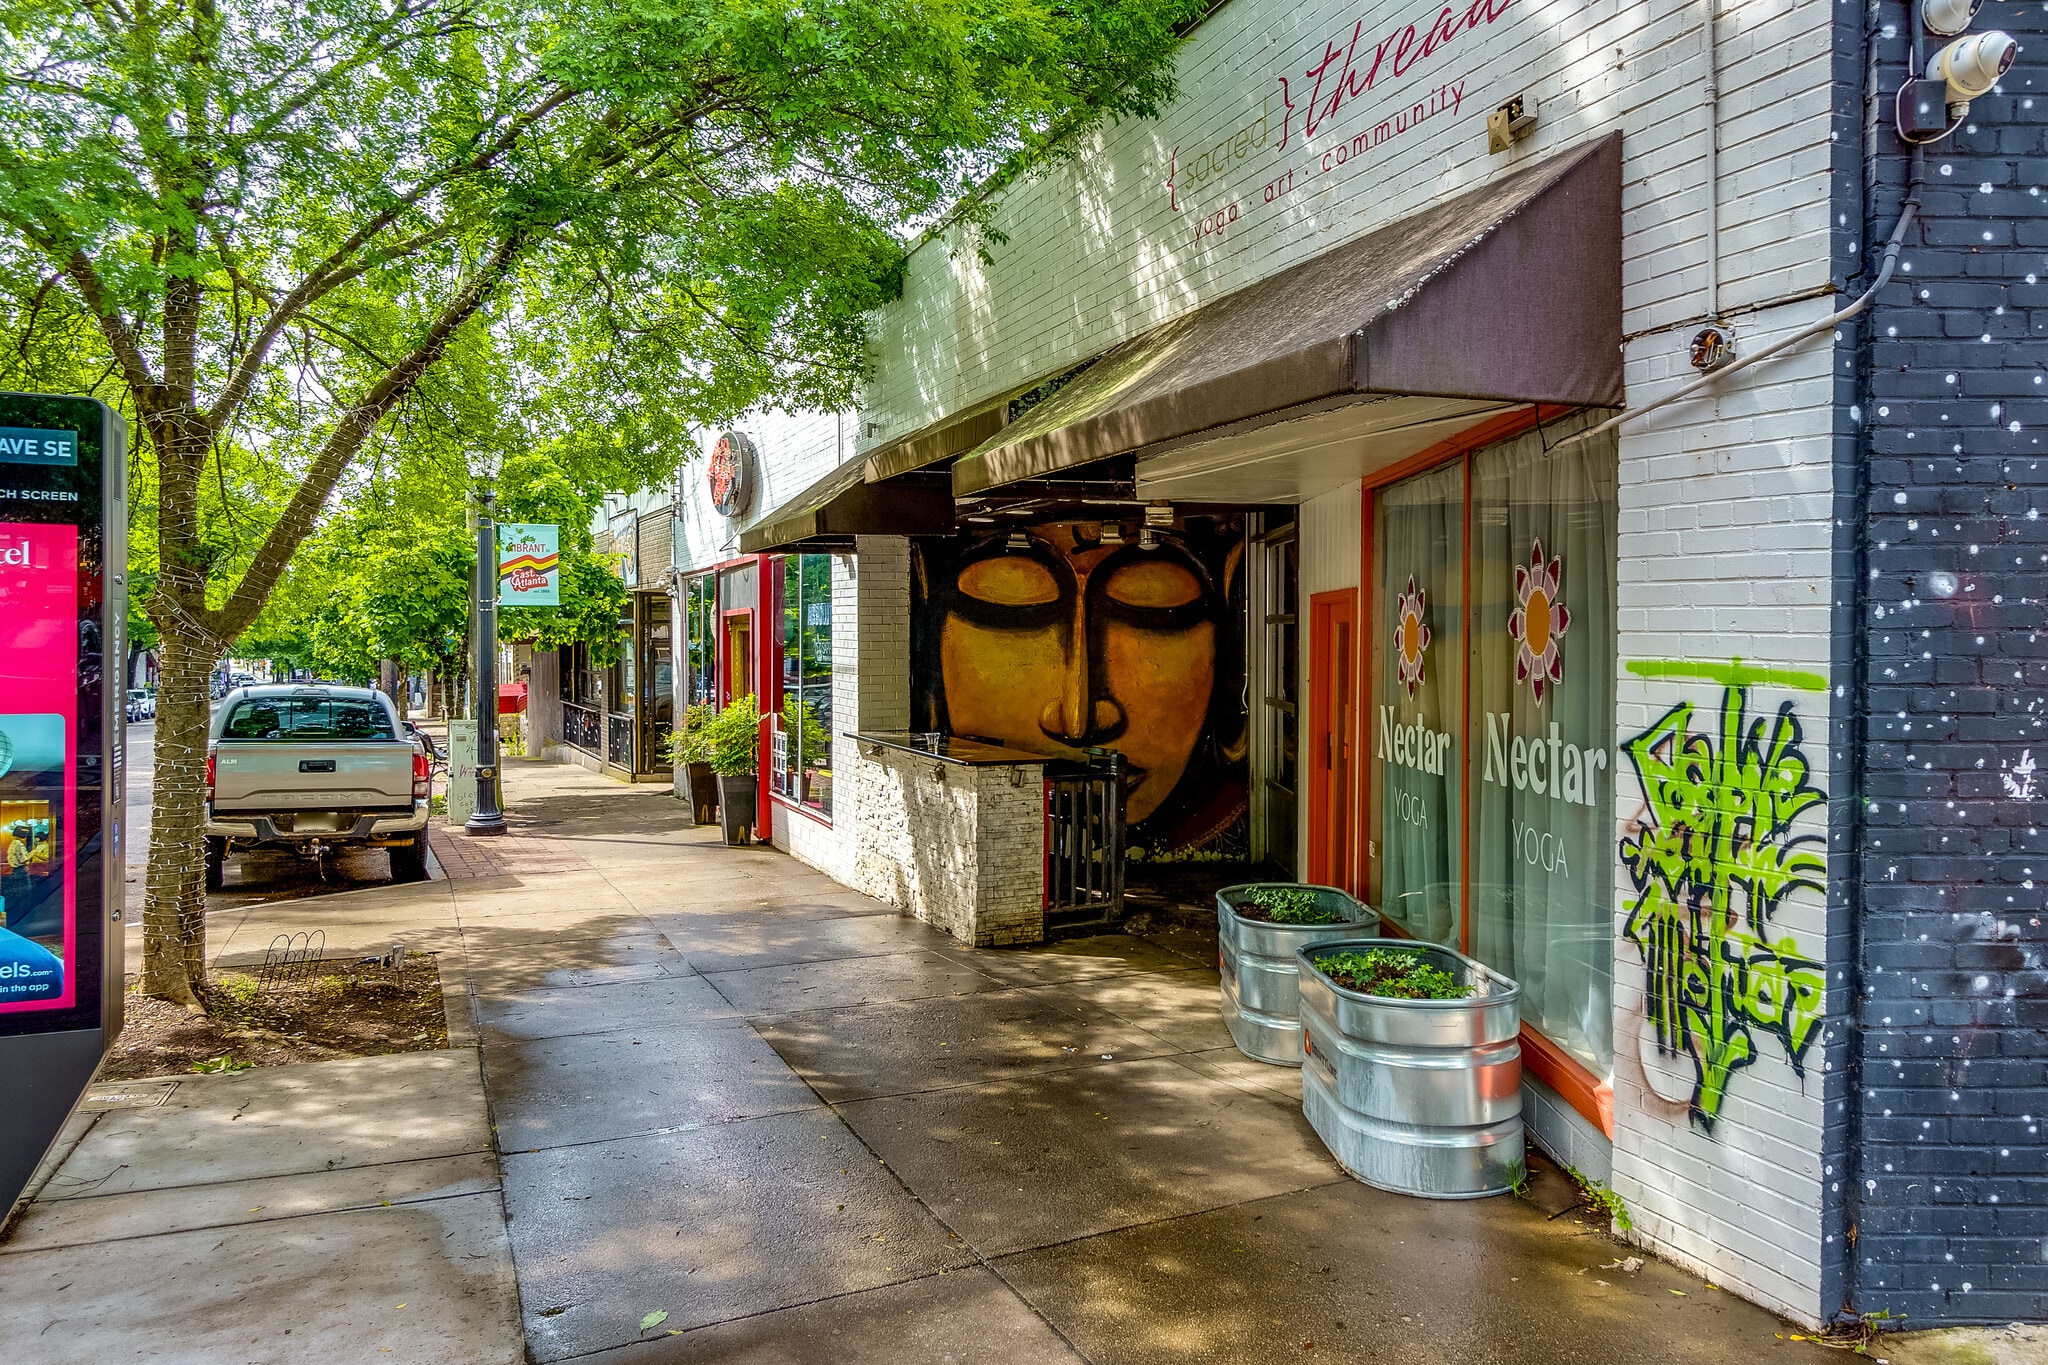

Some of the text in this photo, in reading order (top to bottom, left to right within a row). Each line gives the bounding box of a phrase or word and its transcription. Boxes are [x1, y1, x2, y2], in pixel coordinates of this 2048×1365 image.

[1194, 81, 1465, 248] yoga art community
[0, 438, 72, 457] AVE SE
[21, 490, 79, 501] SCREEN
[508, 543, 546, 552] IBRANT
[511, 575, 547, 588] Atlanta
[512, 568, 536, 579] East
[1378, 705, 1451, 776] Nectar
[1484, 712, 1607, 807] Nectar
[261, 793, 374, 802] TACOMA
[1394, 786, 1428, 830] YOGA
[1512, 818, 1569, 879] YOGA
[10, 984, 27, 992] the
[29, 983, 49, 992] app
